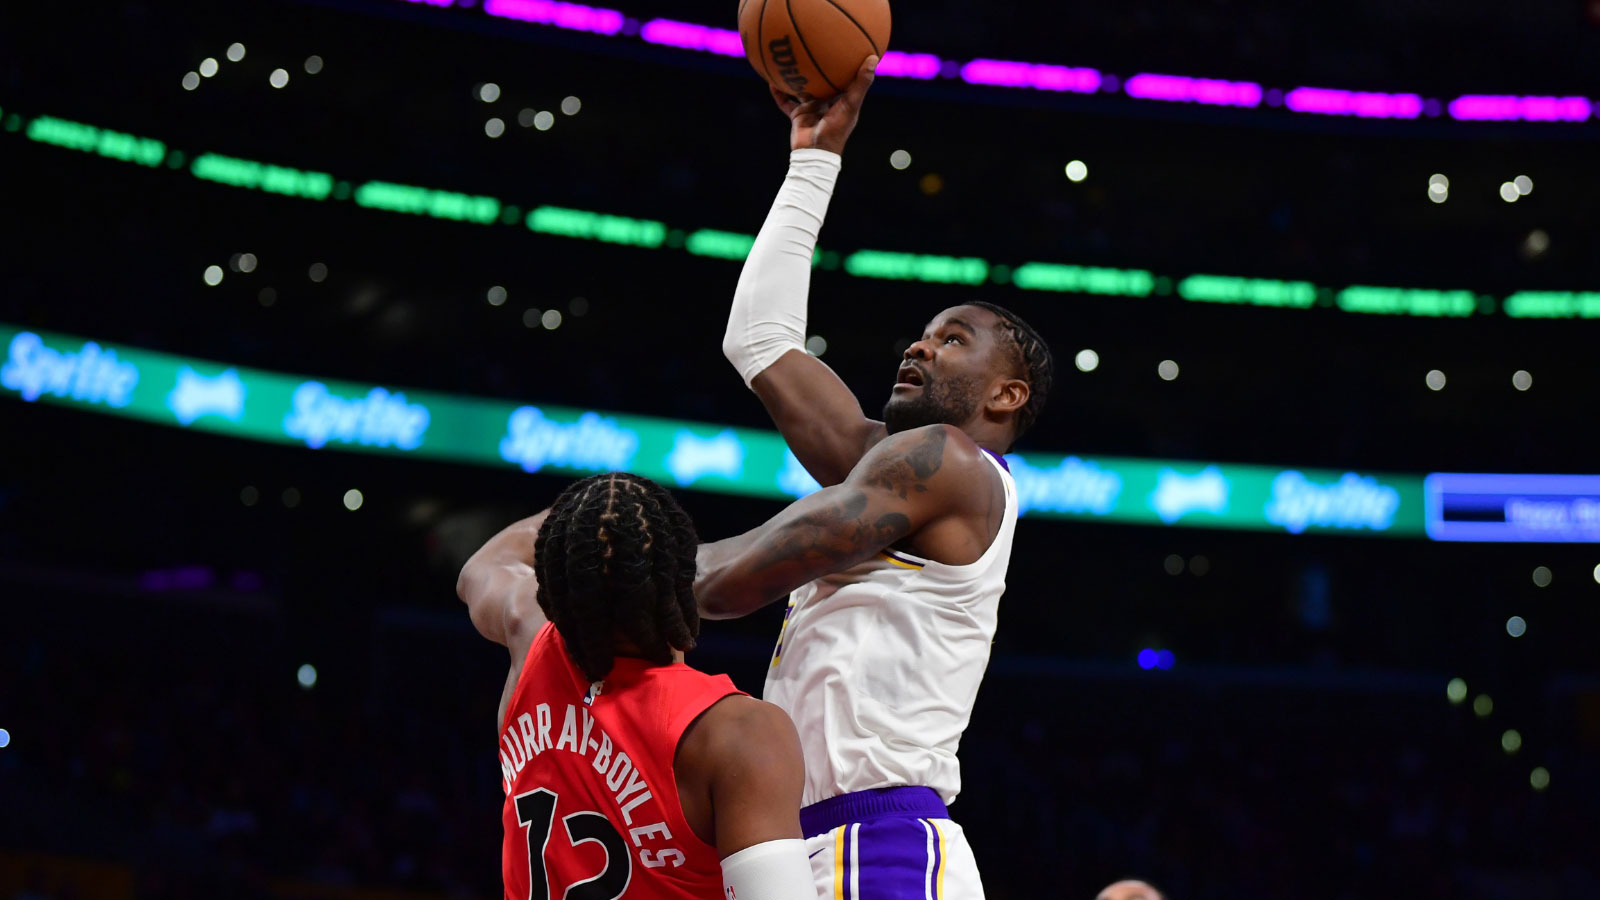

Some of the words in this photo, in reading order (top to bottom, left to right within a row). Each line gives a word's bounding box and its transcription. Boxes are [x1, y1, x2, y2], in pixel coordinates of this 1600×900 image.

[1, 332, 139, 408] Sprite
[284, 381, 430, 450] Sprite
[500, 703, 686, 869] MURRAY-BOYLES
